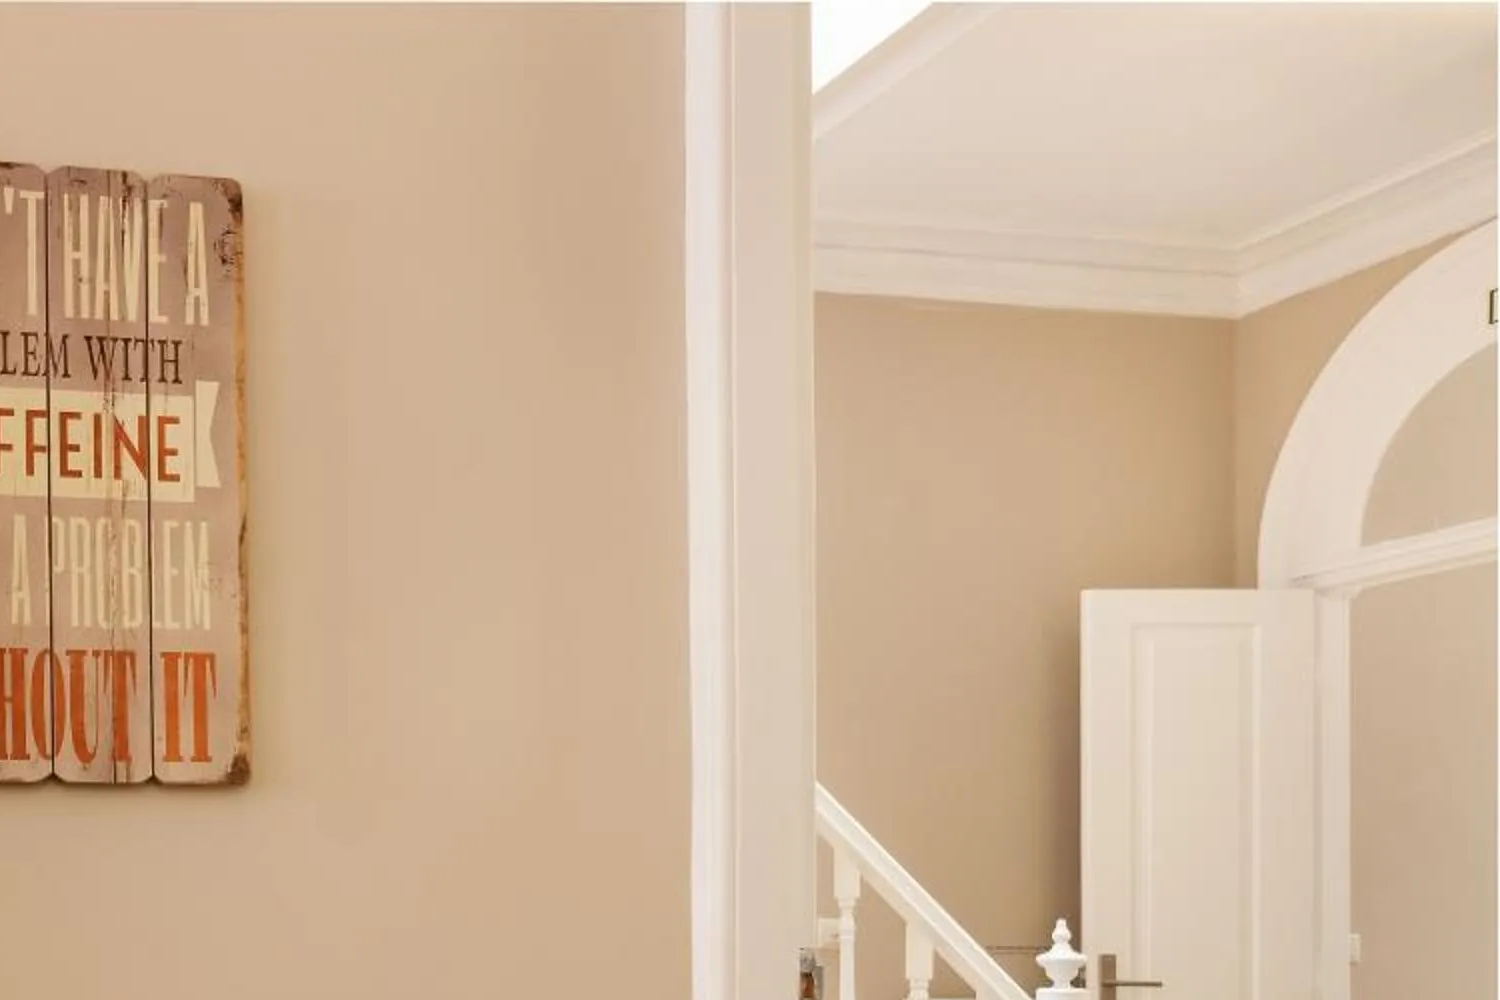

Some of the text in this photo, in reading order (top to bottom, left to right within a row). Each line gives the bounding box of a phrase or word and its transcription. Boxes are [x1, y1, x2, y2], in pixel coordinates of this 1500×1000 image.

[63, 192, 170, 324] HAVE
[184, 201, 210, 326] A
[83, 335, 184, 385] WITH
[11, 514, 31, 627] A
[46, 516, 212, 630] PROBLEM
[159, 650, 218, 764] IT
